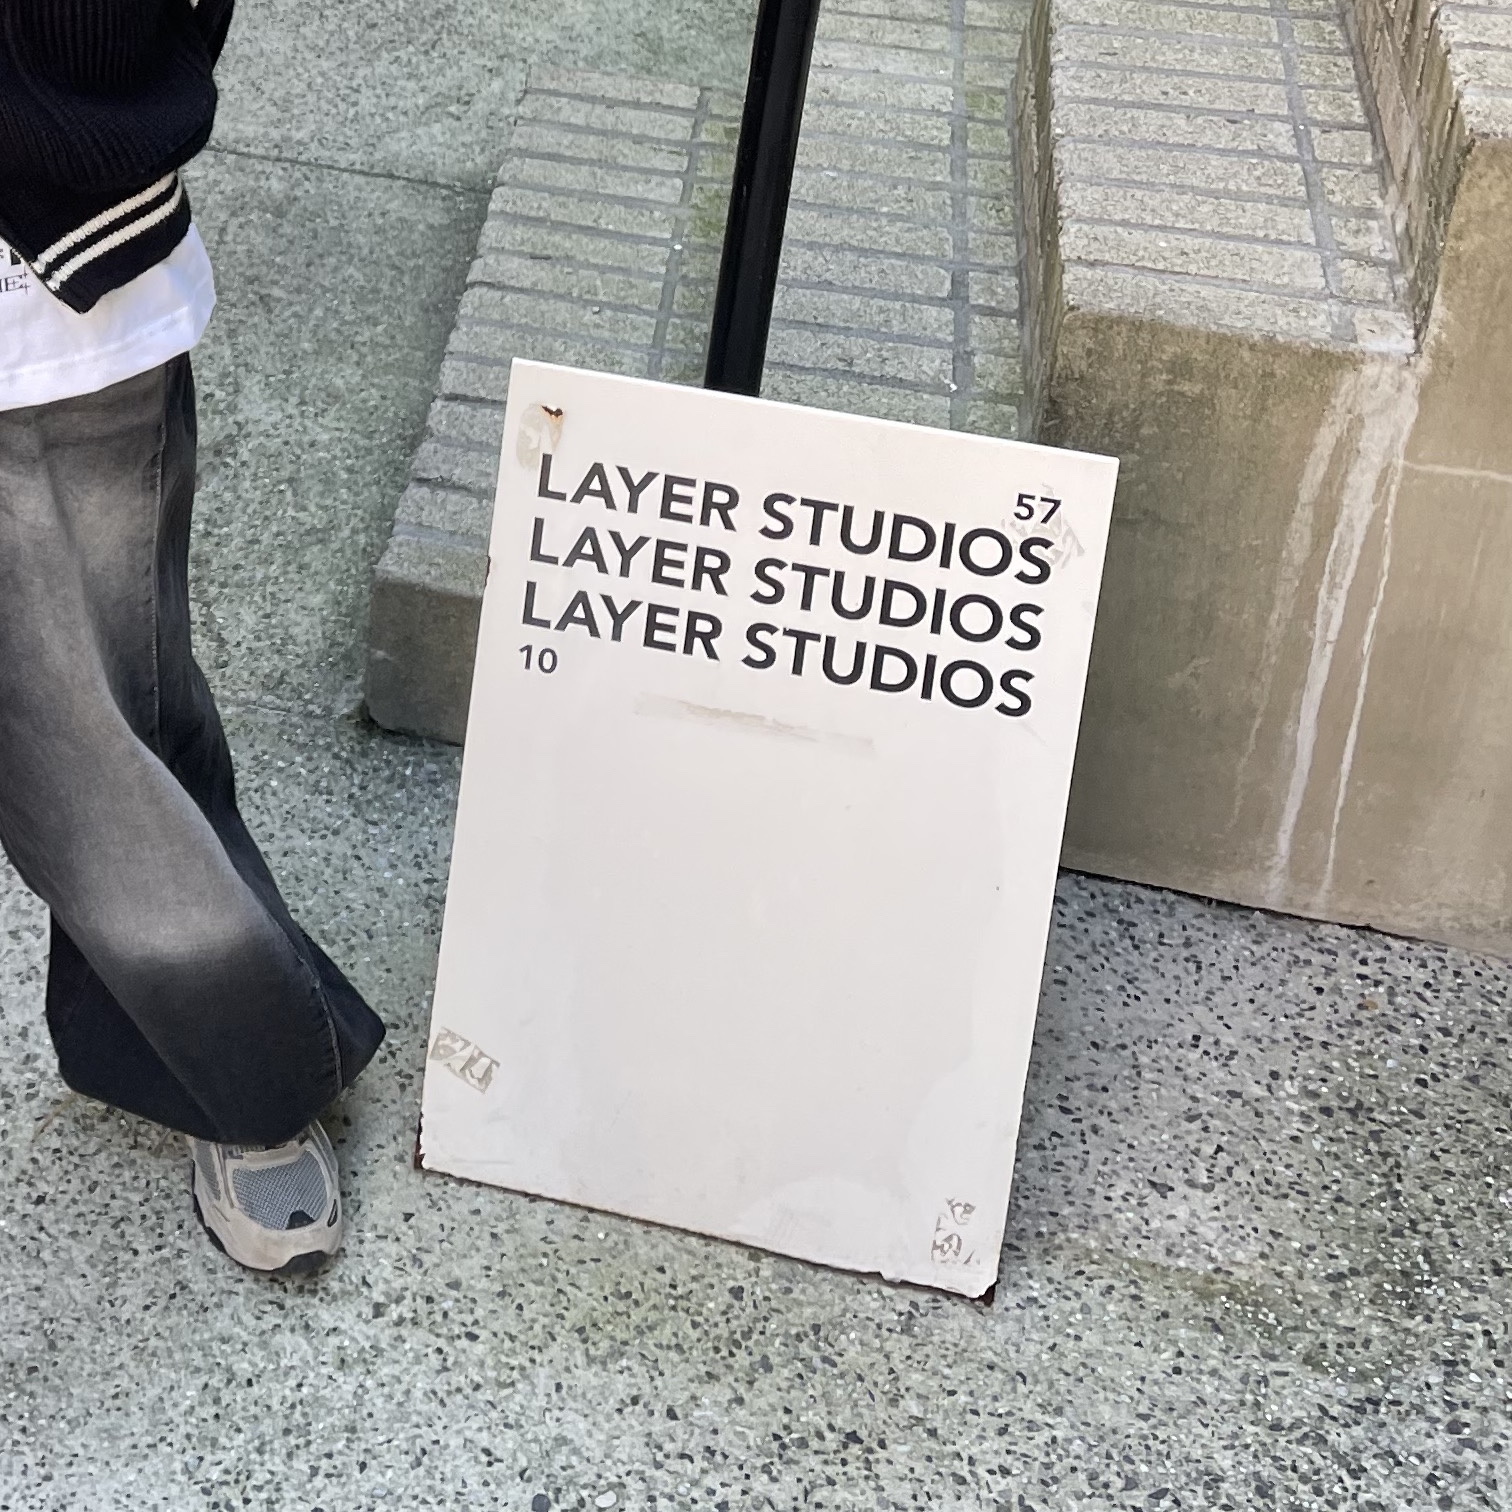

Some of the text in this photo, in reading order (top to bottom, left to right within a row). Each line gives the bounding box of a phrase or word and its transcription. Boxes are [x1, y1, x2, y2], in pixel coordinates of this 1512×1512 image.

[538, 452, 1055, 585] LAYER STUDIOS
[1014, 492, 1062, 525] 57
[522, 580, 1035, 718] LAYER STUDIOS
[530, 516, 1045, 651] LAYER STUDIOS
[519, 644, 558, 674] 10
